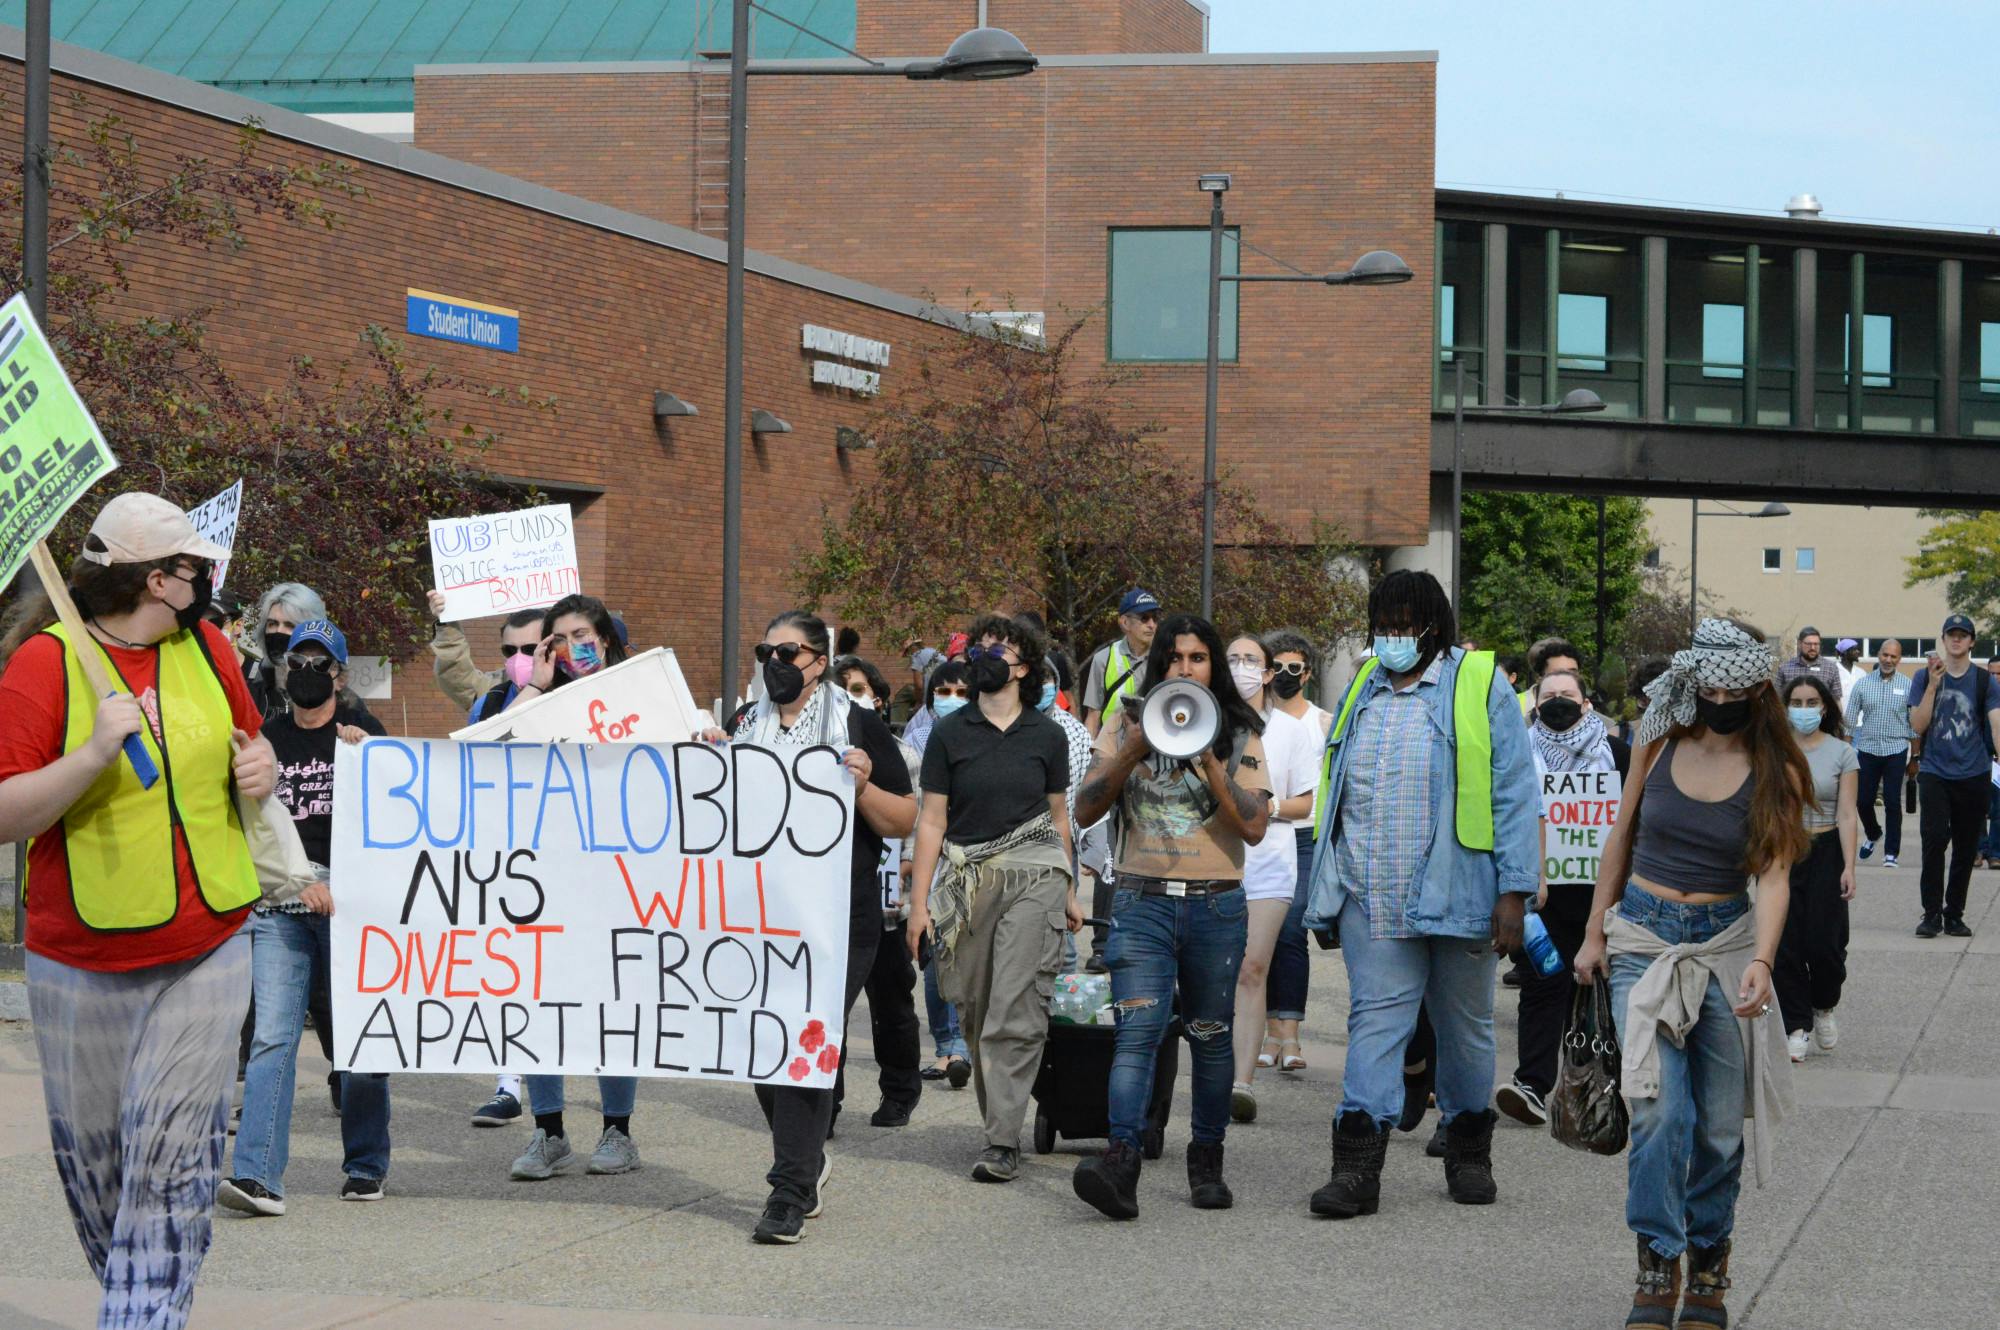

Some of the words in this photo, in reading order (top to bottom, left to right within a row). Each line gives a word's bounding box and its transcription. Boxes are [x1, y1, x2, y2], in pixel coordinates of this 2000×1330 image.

[427, 303, 469, 339] Student
[471, 312, 501, 345] Union
[21, 496, 61, 541] WORLD
[62, 455, 100, 497] PARTY
[434, 521, 491, 557] UB
[494, 513, 567, 545] FUNDS
[440, 558, 497, 587] POLICE
[489, 567, 581, 608] BRUTALITY
[587, 699, 640, 743] for
[1556, 828, 1599, 848] THE
[400, 848, 545, 925] NYS
[615, 853, 801, 938] WILL
[357, 924, 564, 1000] DIVEST
[611, 928, 812, 1013] FROM
[348, 998, 789, 1080] APARTHEID
